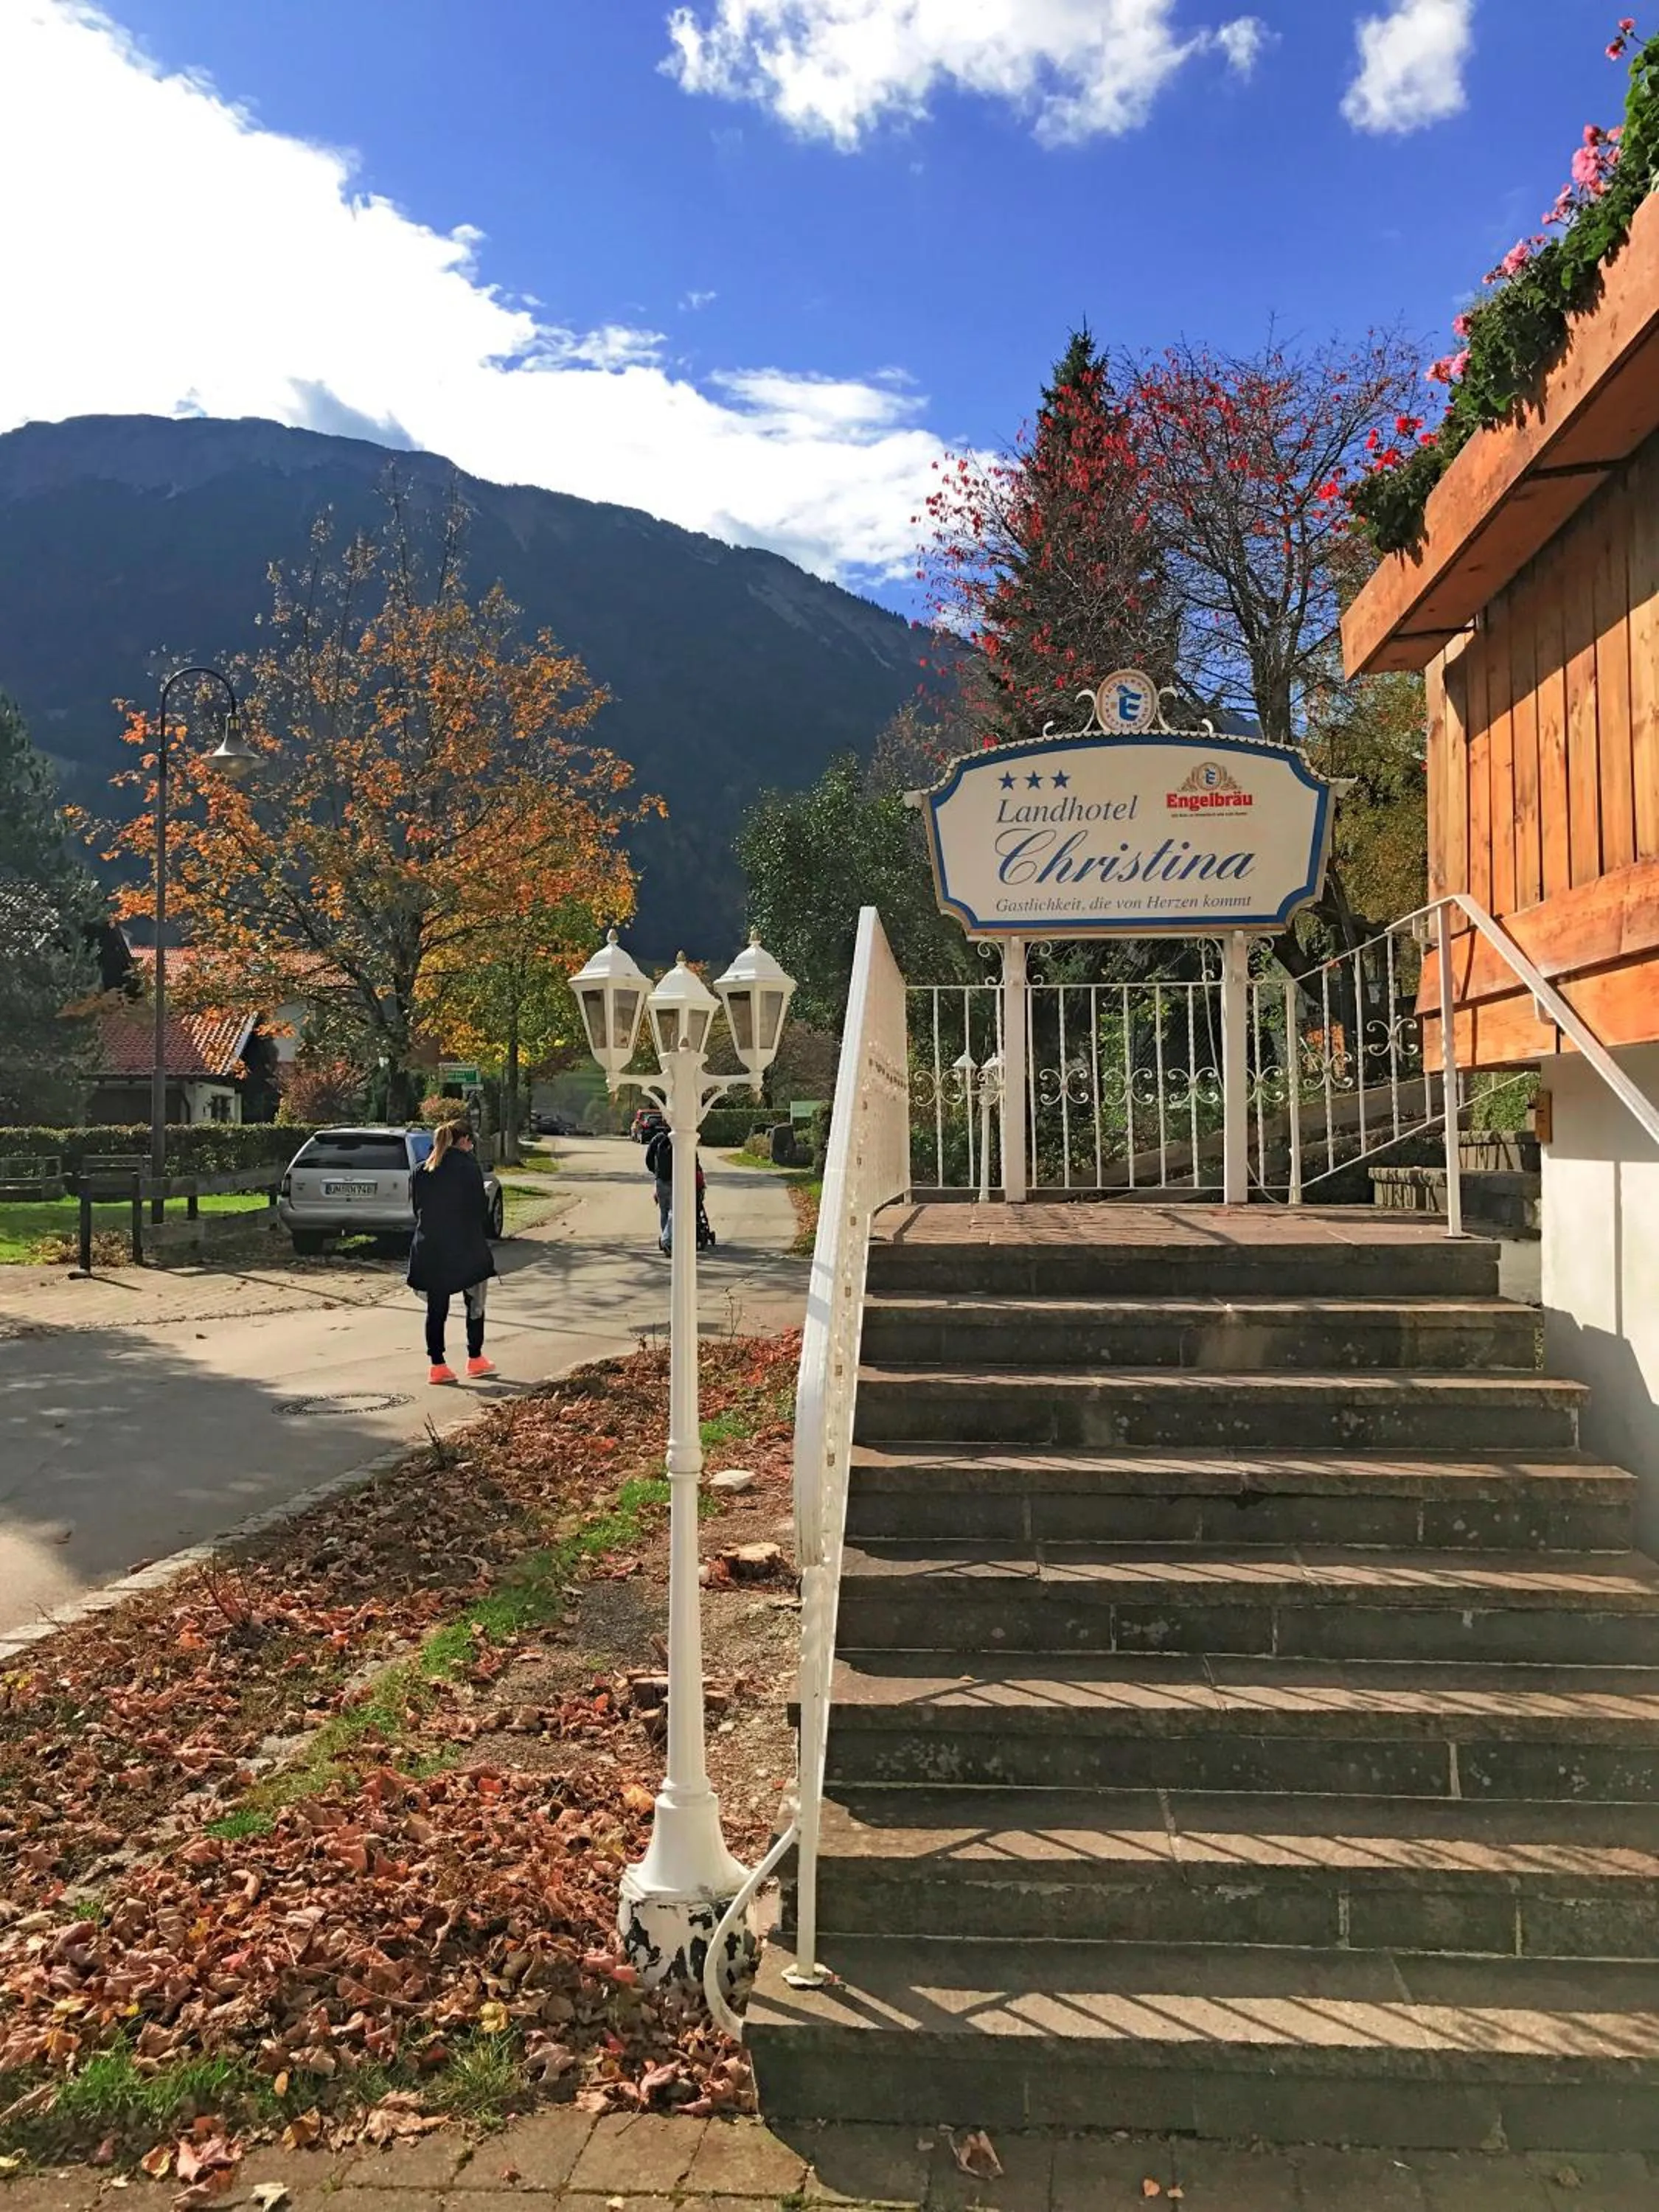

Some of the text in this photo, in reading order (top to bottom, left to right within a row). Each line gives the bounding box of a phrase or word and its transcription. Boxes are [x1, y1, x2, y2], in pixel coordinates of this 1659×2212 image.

[995, 795, 1138, 824] Landhotel
[1166, 791, 1253, 812] Engelbräu
[995, 828, 1256, 885] Christina
[996, 894, 1251, 913] Gastlichkeit, die von Herzen kommt
